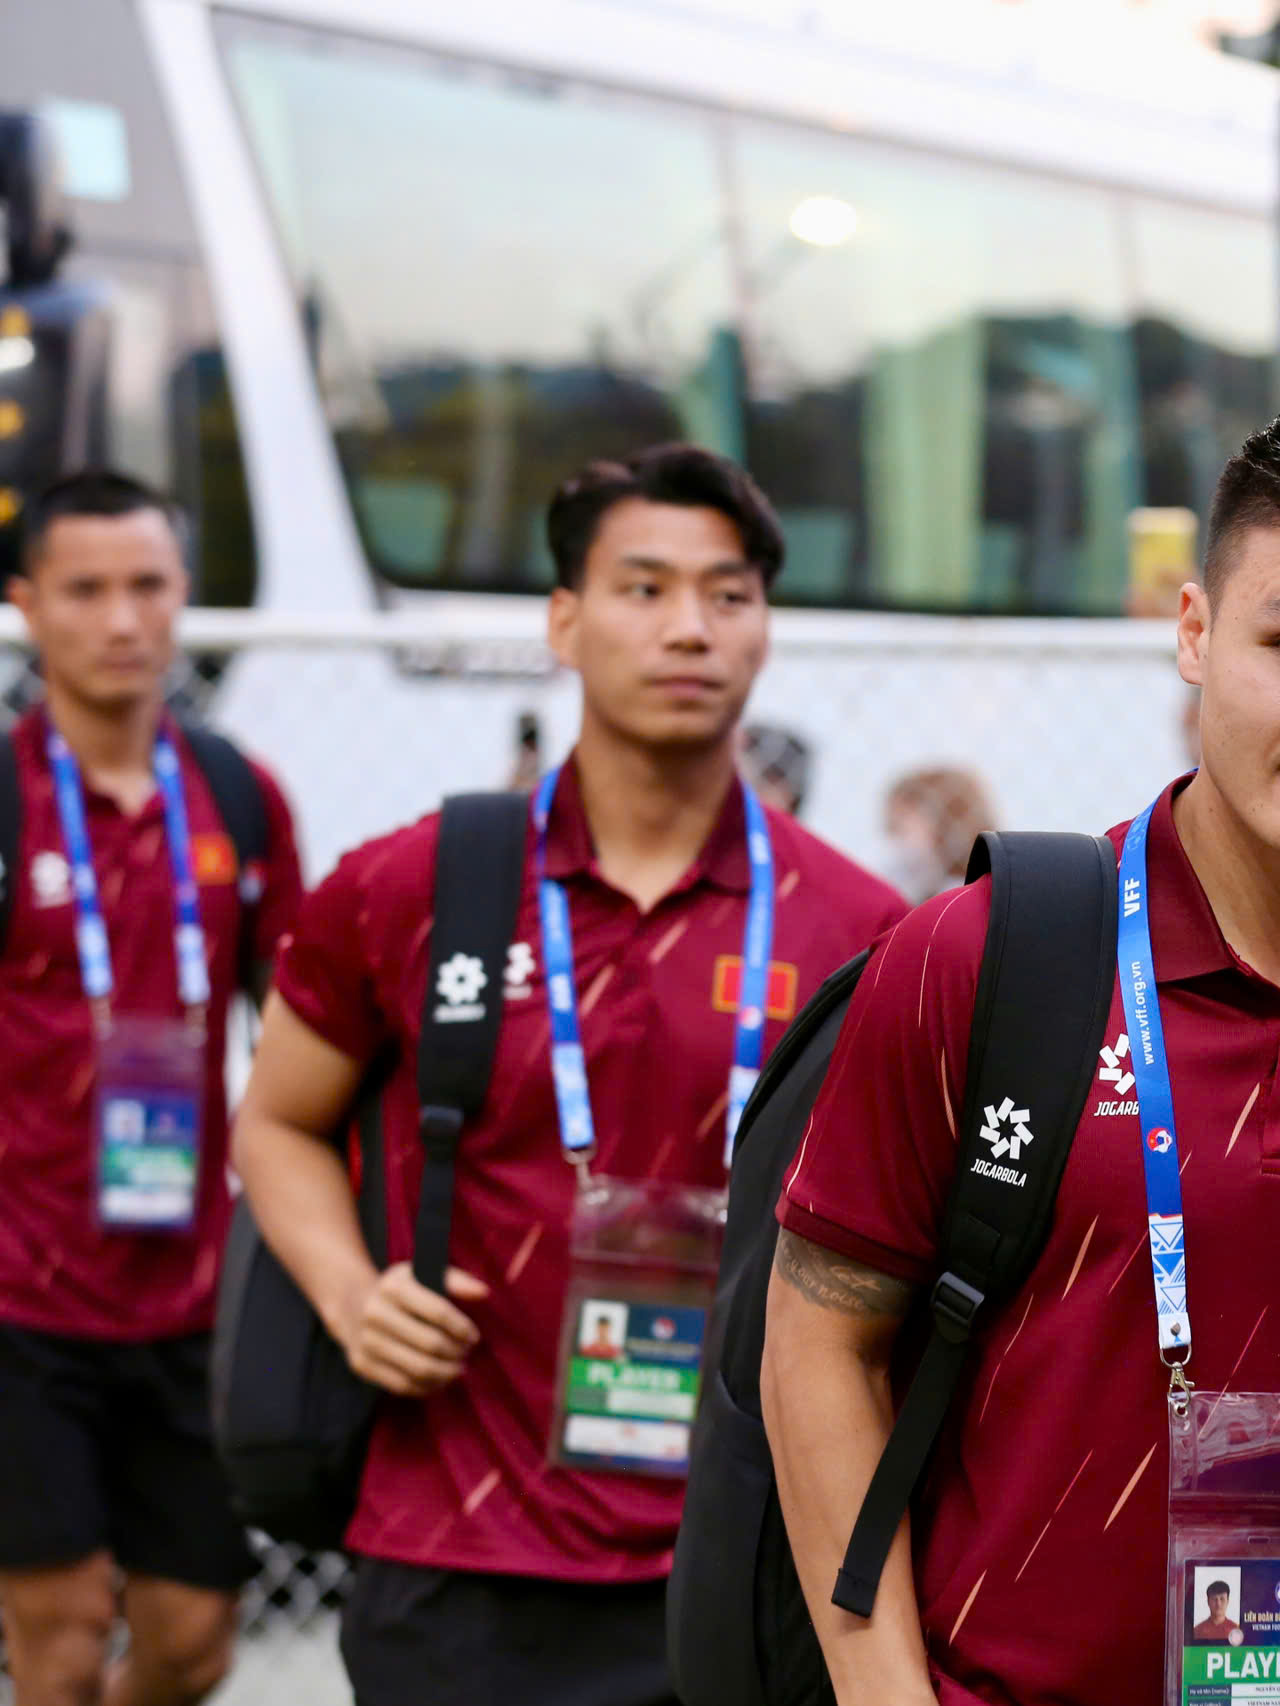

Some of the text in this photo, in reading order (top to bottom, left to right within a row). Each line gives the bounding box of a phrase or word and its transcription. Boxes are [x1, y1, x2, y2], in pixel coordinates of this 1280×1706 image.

[1124, 877, 1141, 918] VFF
[1131, 961, 1155, 1065] www.vff.org.vn
[1094, 1101, 1139, 1116] JOGARB
[970, 1158, 1028, 1188] JOGARBOLA
